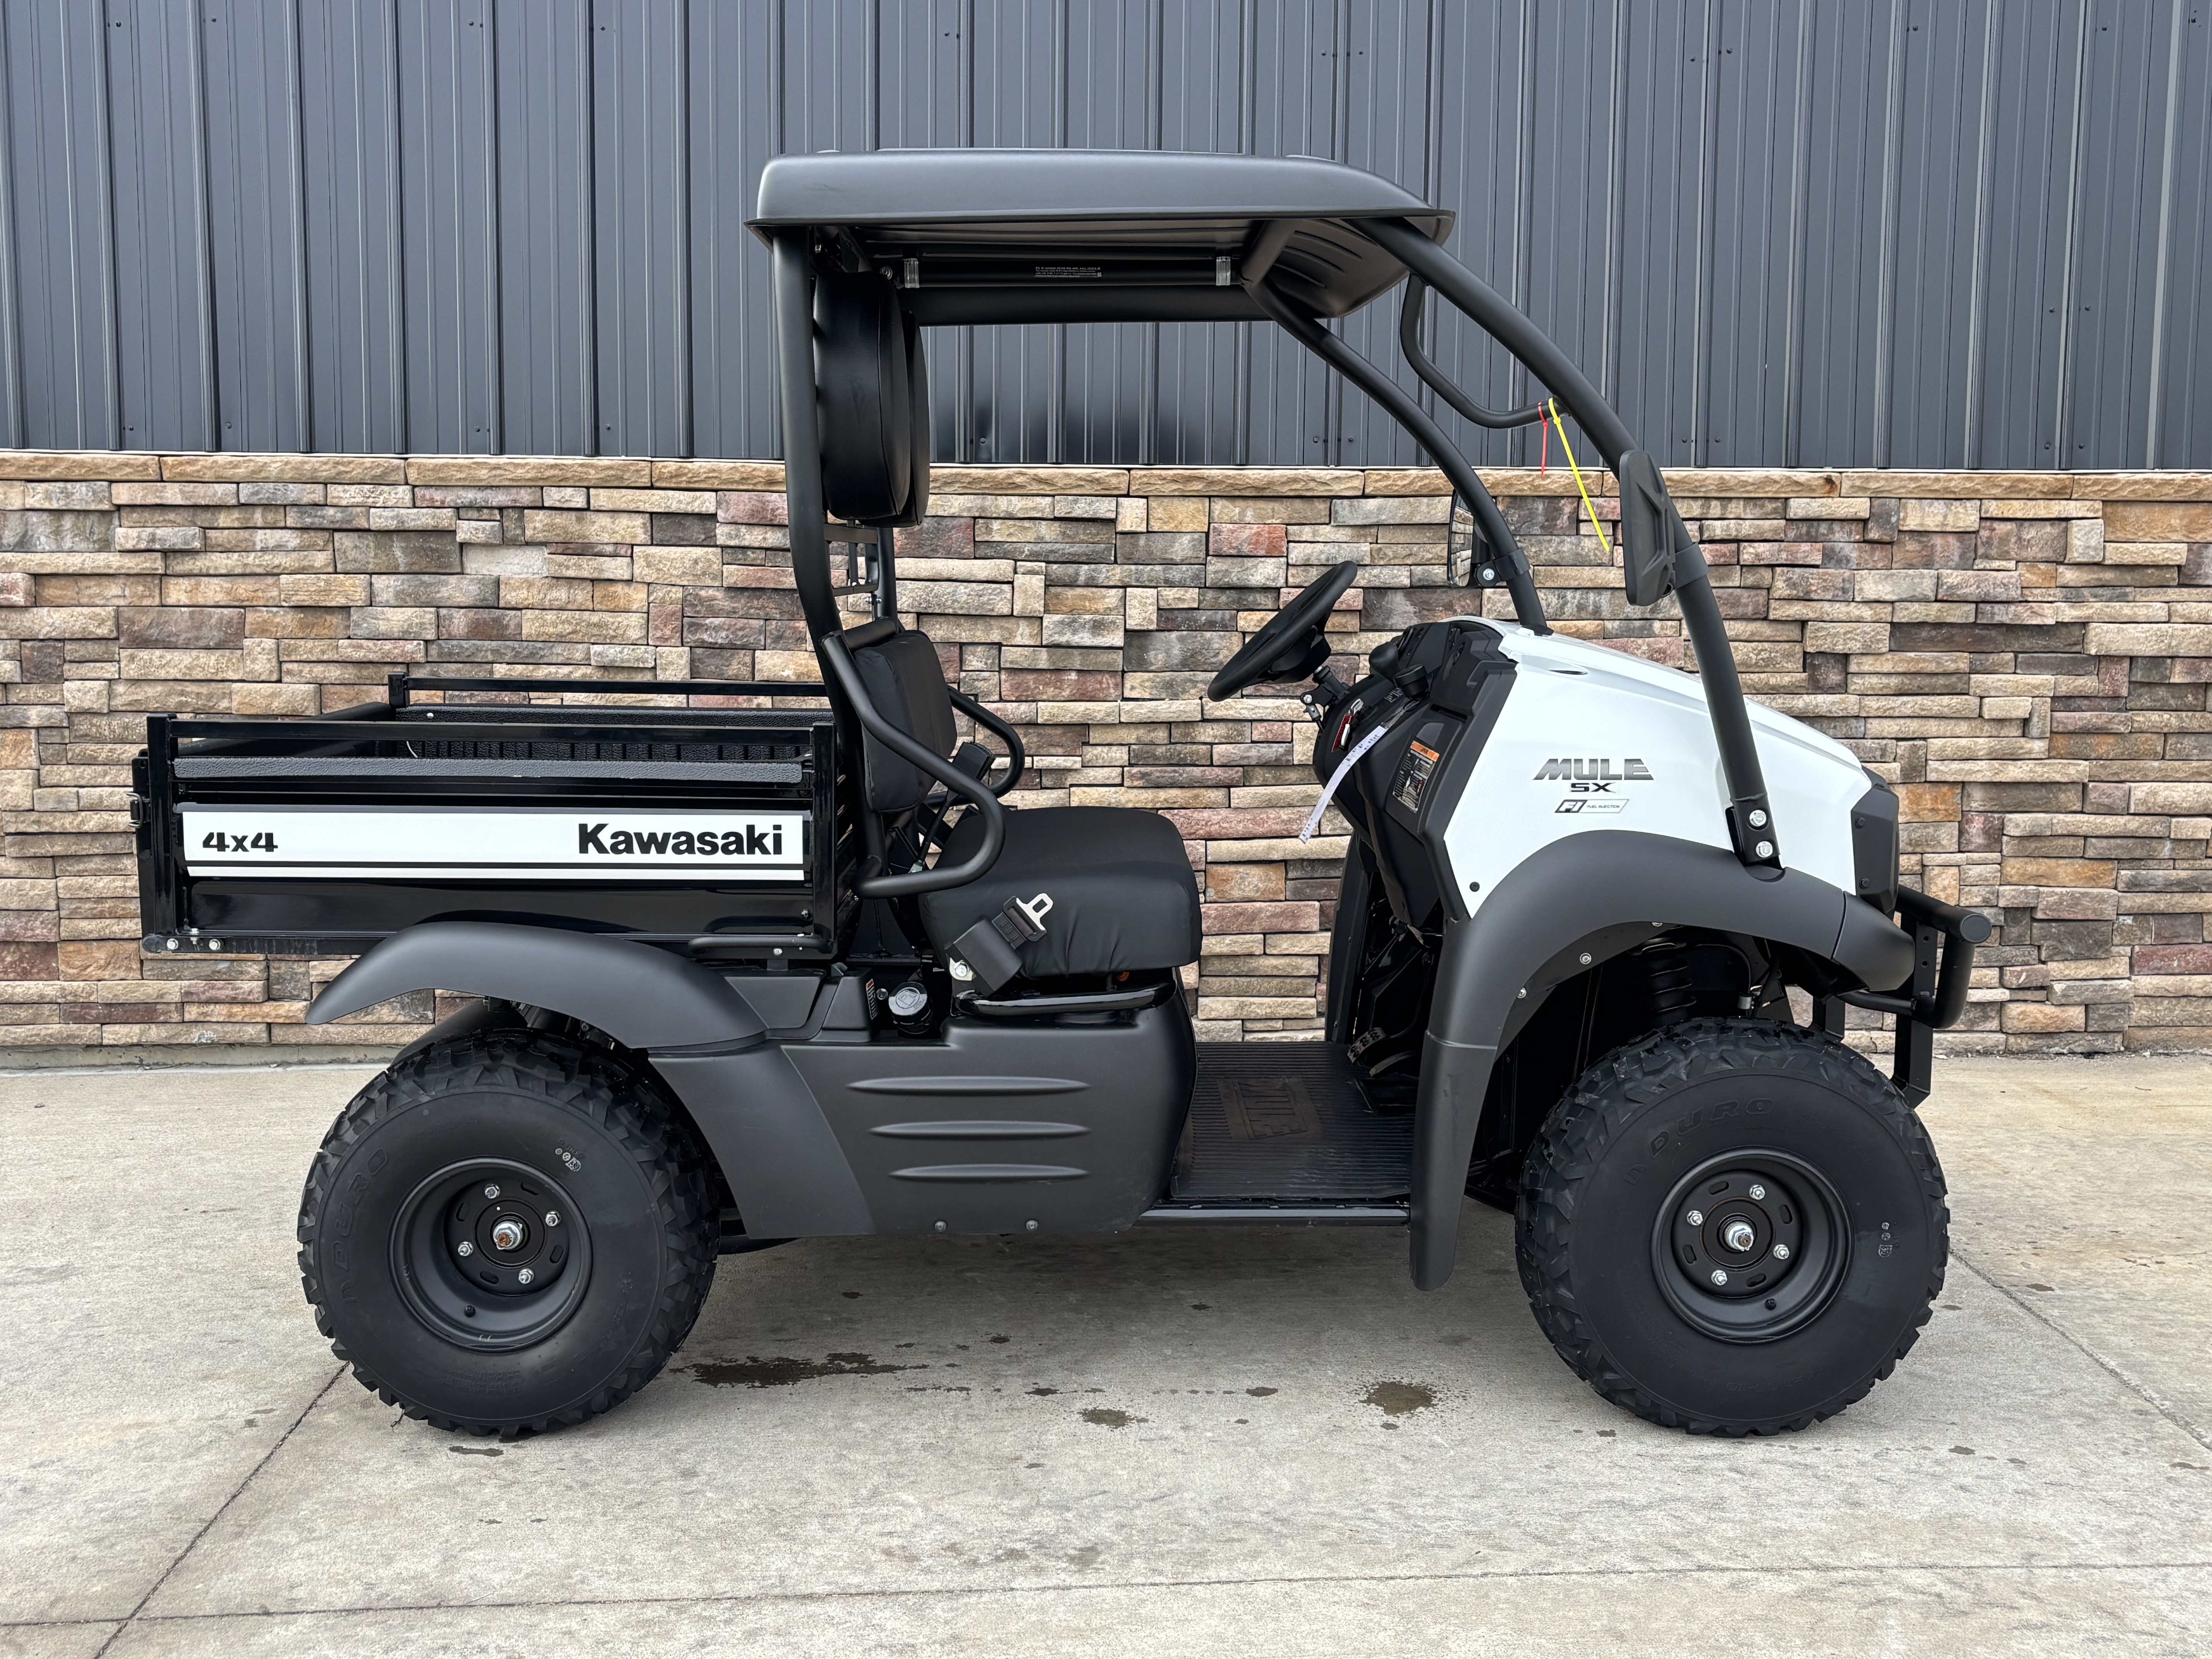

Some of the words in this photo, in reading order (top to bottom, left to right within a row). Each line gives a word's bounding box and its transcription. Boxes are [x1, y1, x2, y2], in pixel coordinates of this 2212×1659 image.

[1532, 758, 1654, 780] MULE
[1570, 782, 1616, 793] SX
[203, 832, 278, 852] 4x4
[578, 823, 782, 855] Kawasaki
[1648, 1097, 1774, 1158] DURO
[331, 1147, 388, 1271] DURO
